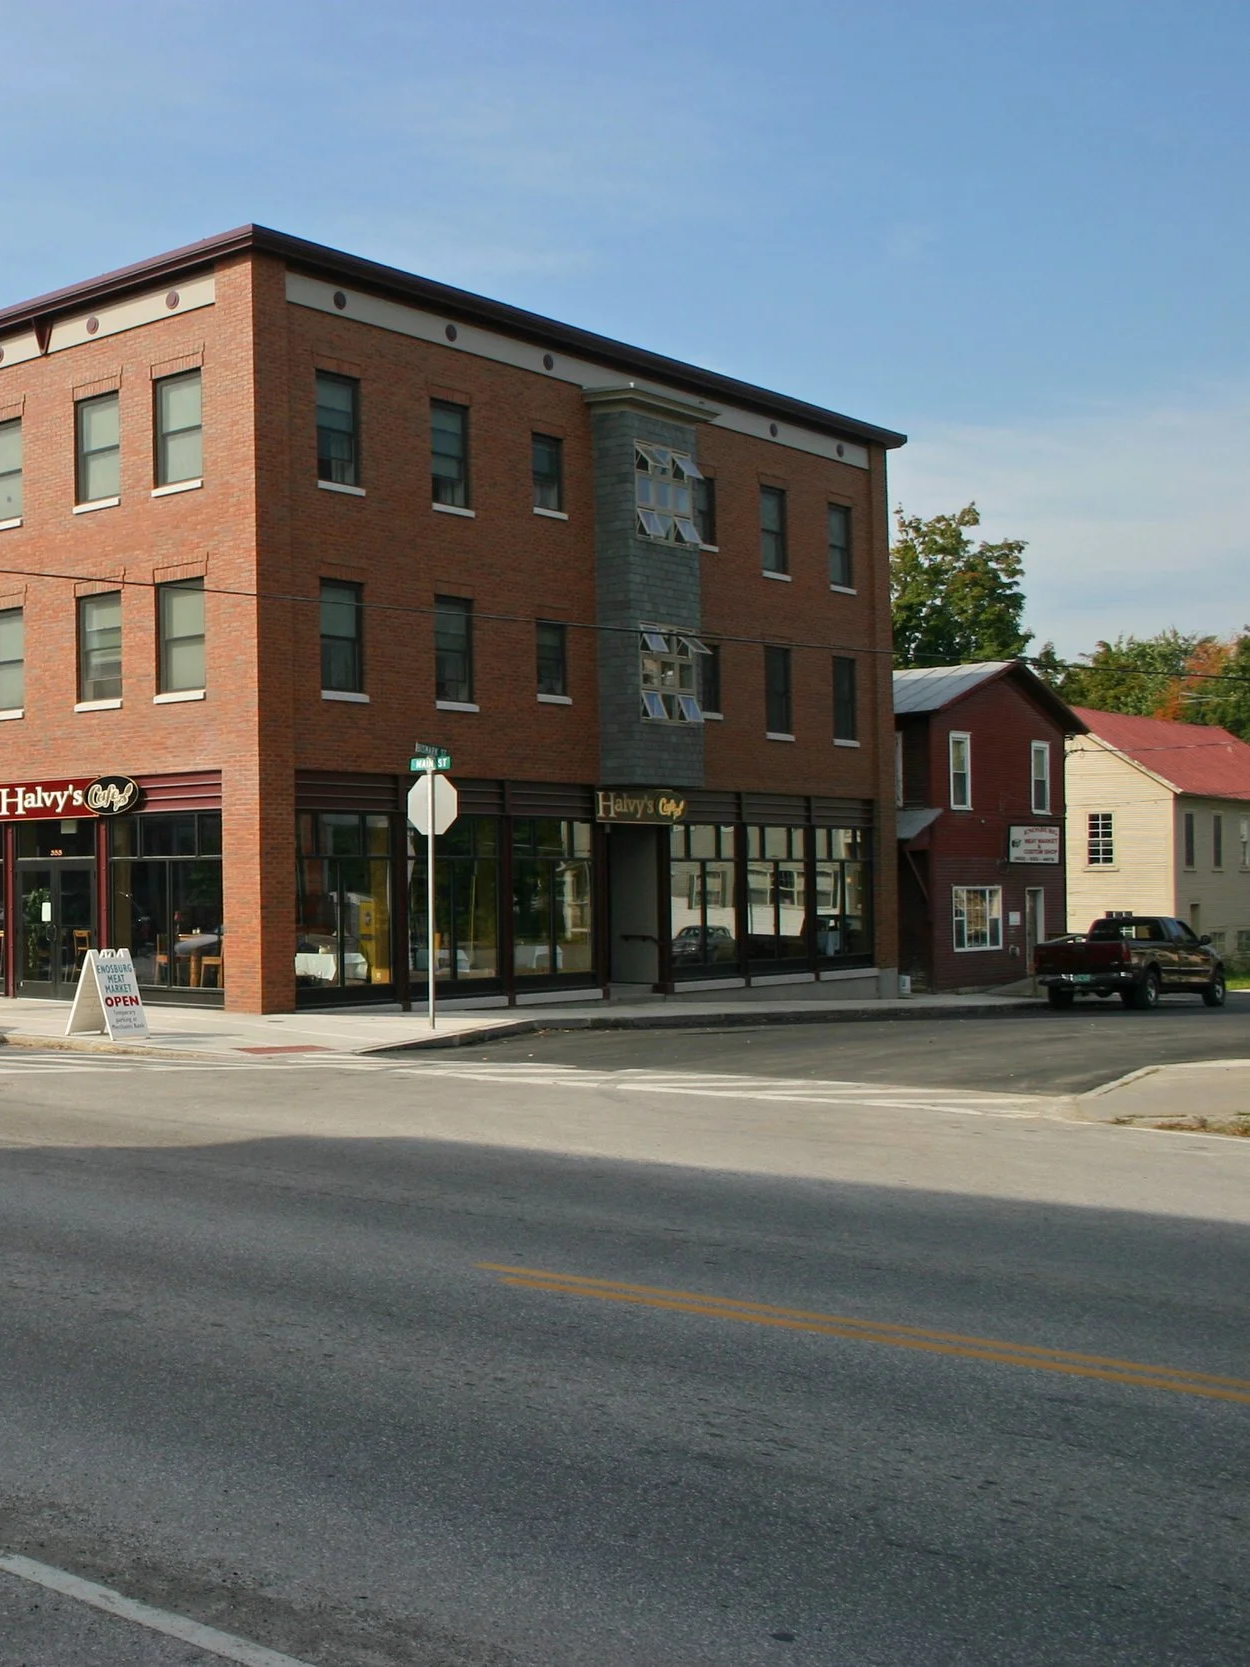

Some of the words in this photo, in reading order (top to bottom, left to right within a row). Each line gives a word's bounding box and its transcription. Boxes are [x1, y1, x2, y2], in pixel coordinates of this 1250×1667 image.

[416, 759, 434, 768] MAIN
[437, 758, 448, 768] ST
[596, 791, 655, 819] Halvy's
[96, 964, 133, 974] ENOSBURG
[107, 974, 125, 983] MEAT
[105, 984, 132, 993] MARKET
[105, 995, 140, 1007] OPEN
